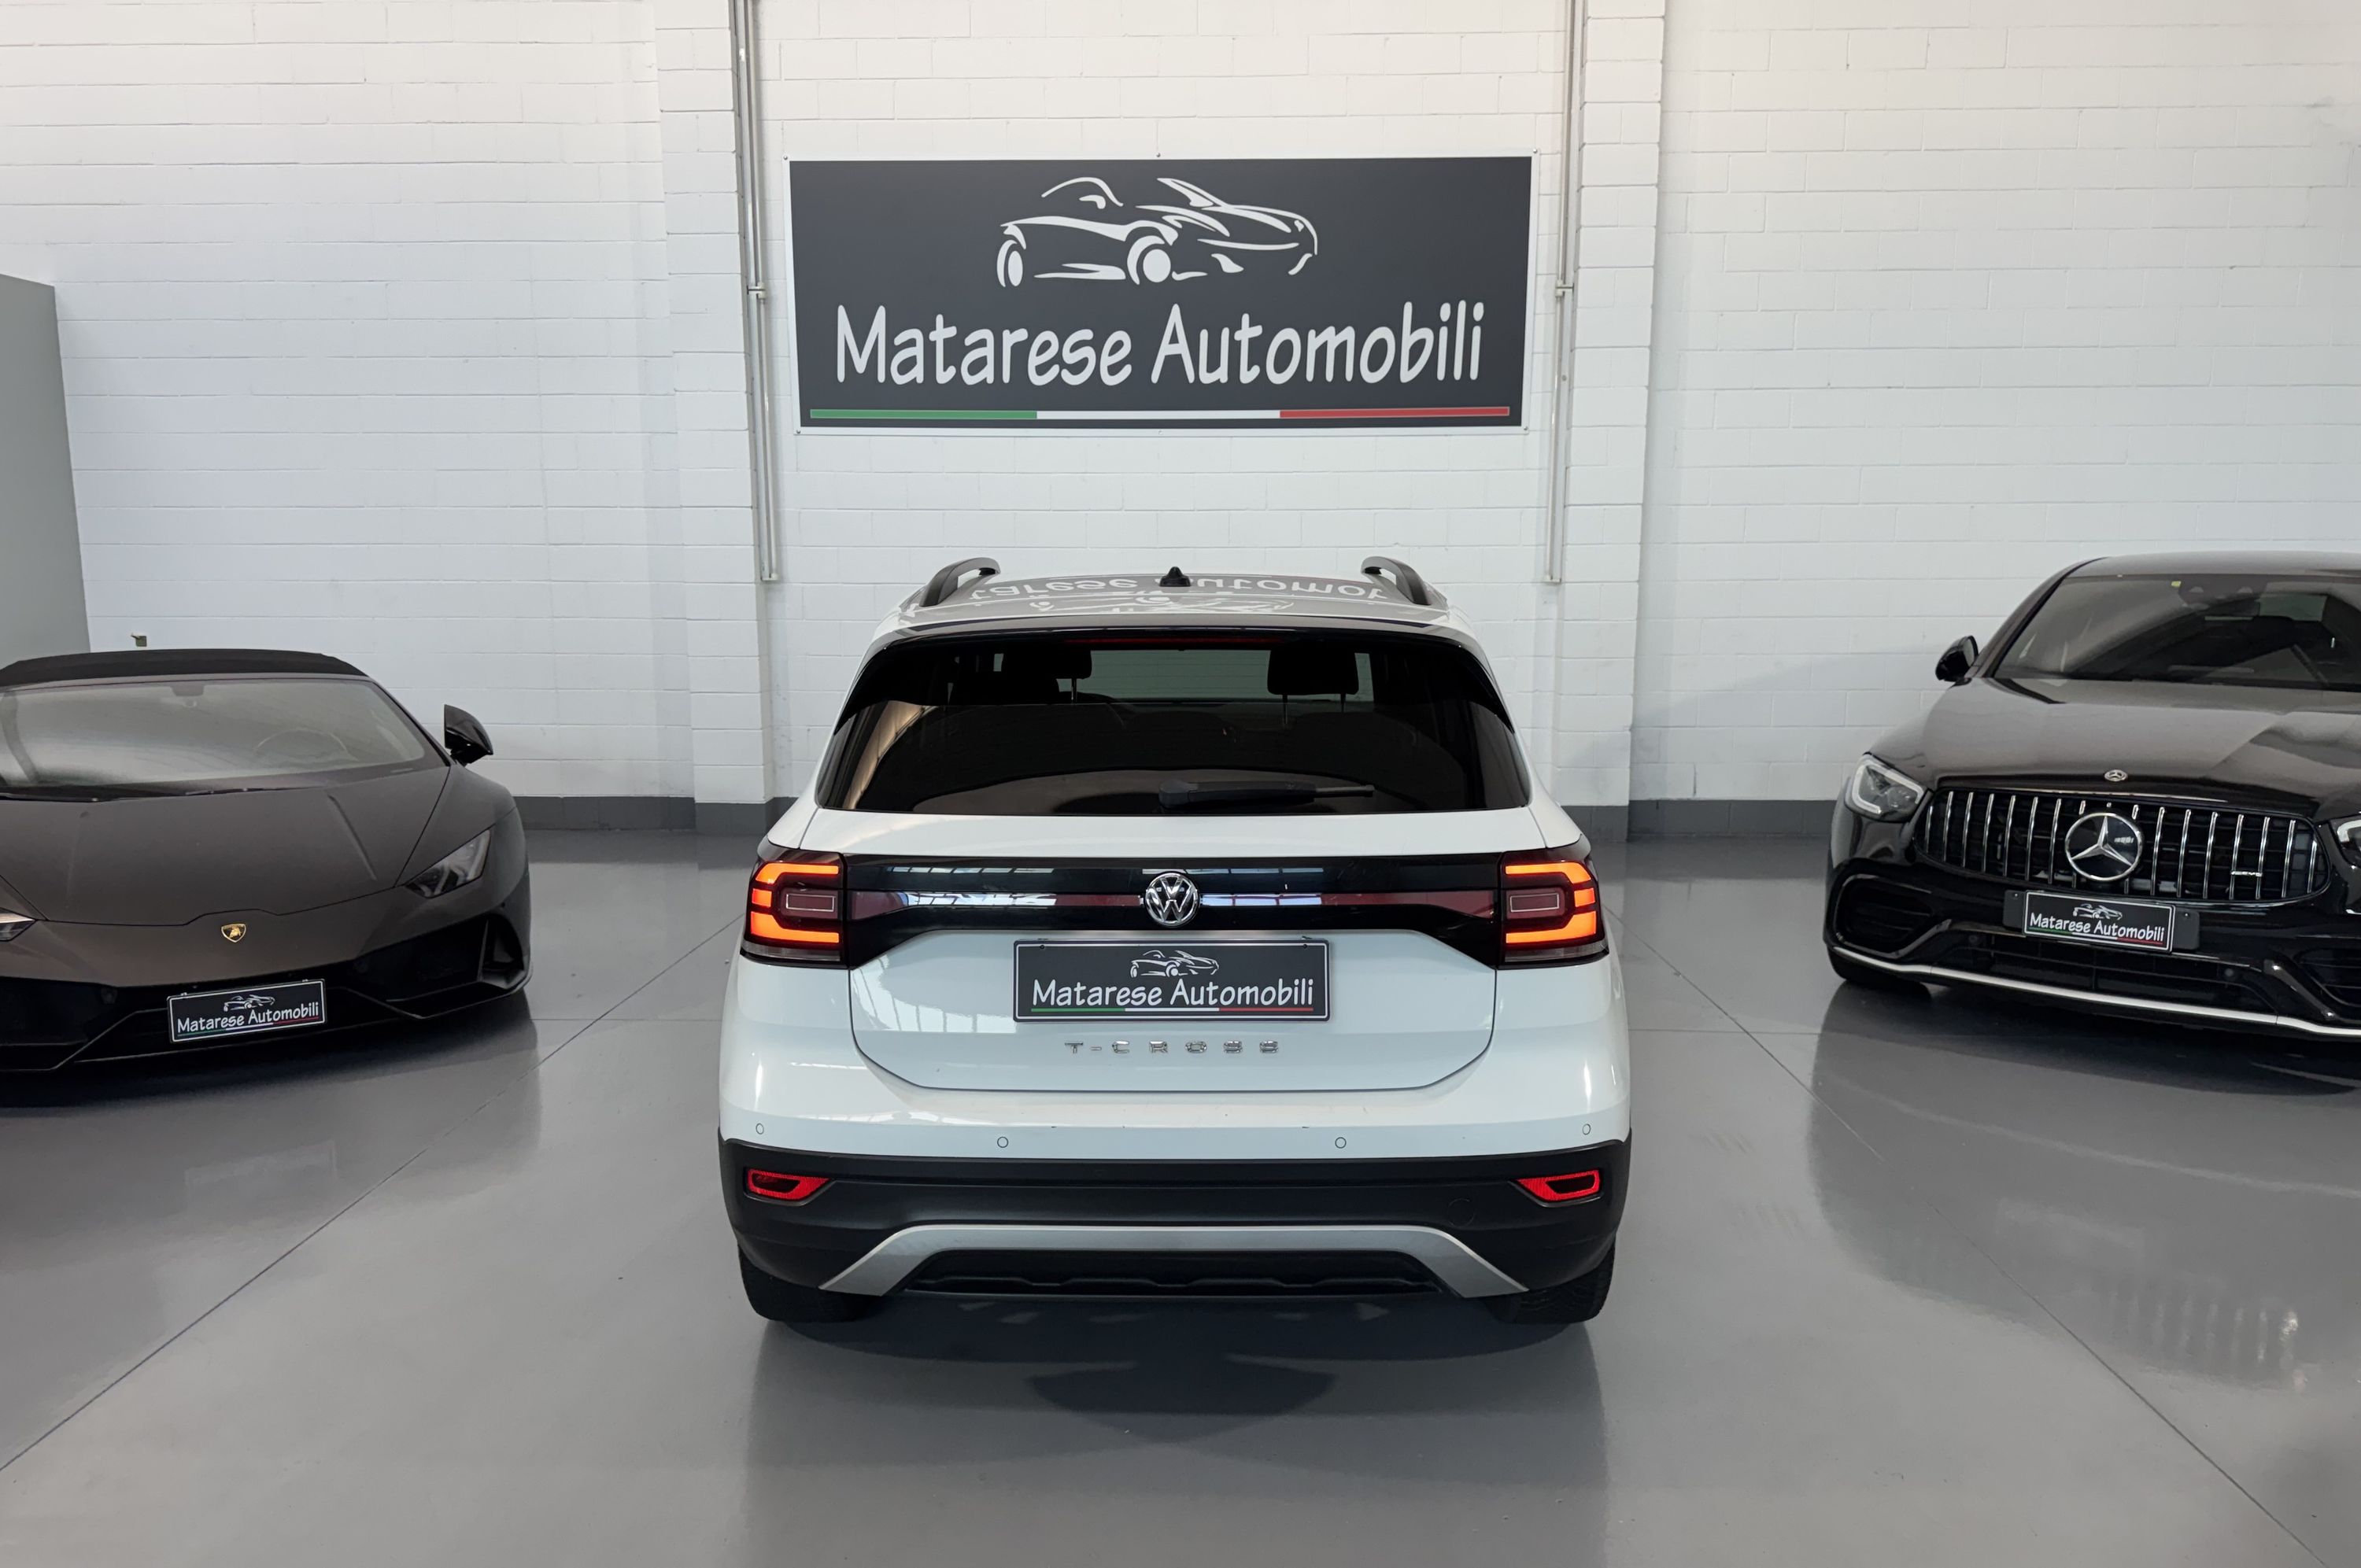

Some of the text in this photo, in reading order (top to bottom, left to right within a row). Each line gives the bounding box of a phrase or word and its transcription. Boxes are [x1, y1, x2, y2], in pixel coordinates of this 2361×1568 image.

[837, 300, 1485, 386] Matarese Automobili
[2030, 912, 2164, 942] Matarese Automobili
[1033, 978, 1314, 1006] Matarese Automobili
[177, 1002, 319, 1033] Matarese Automobili
[1064, 1040, 1279, 1054] T-CROSS
